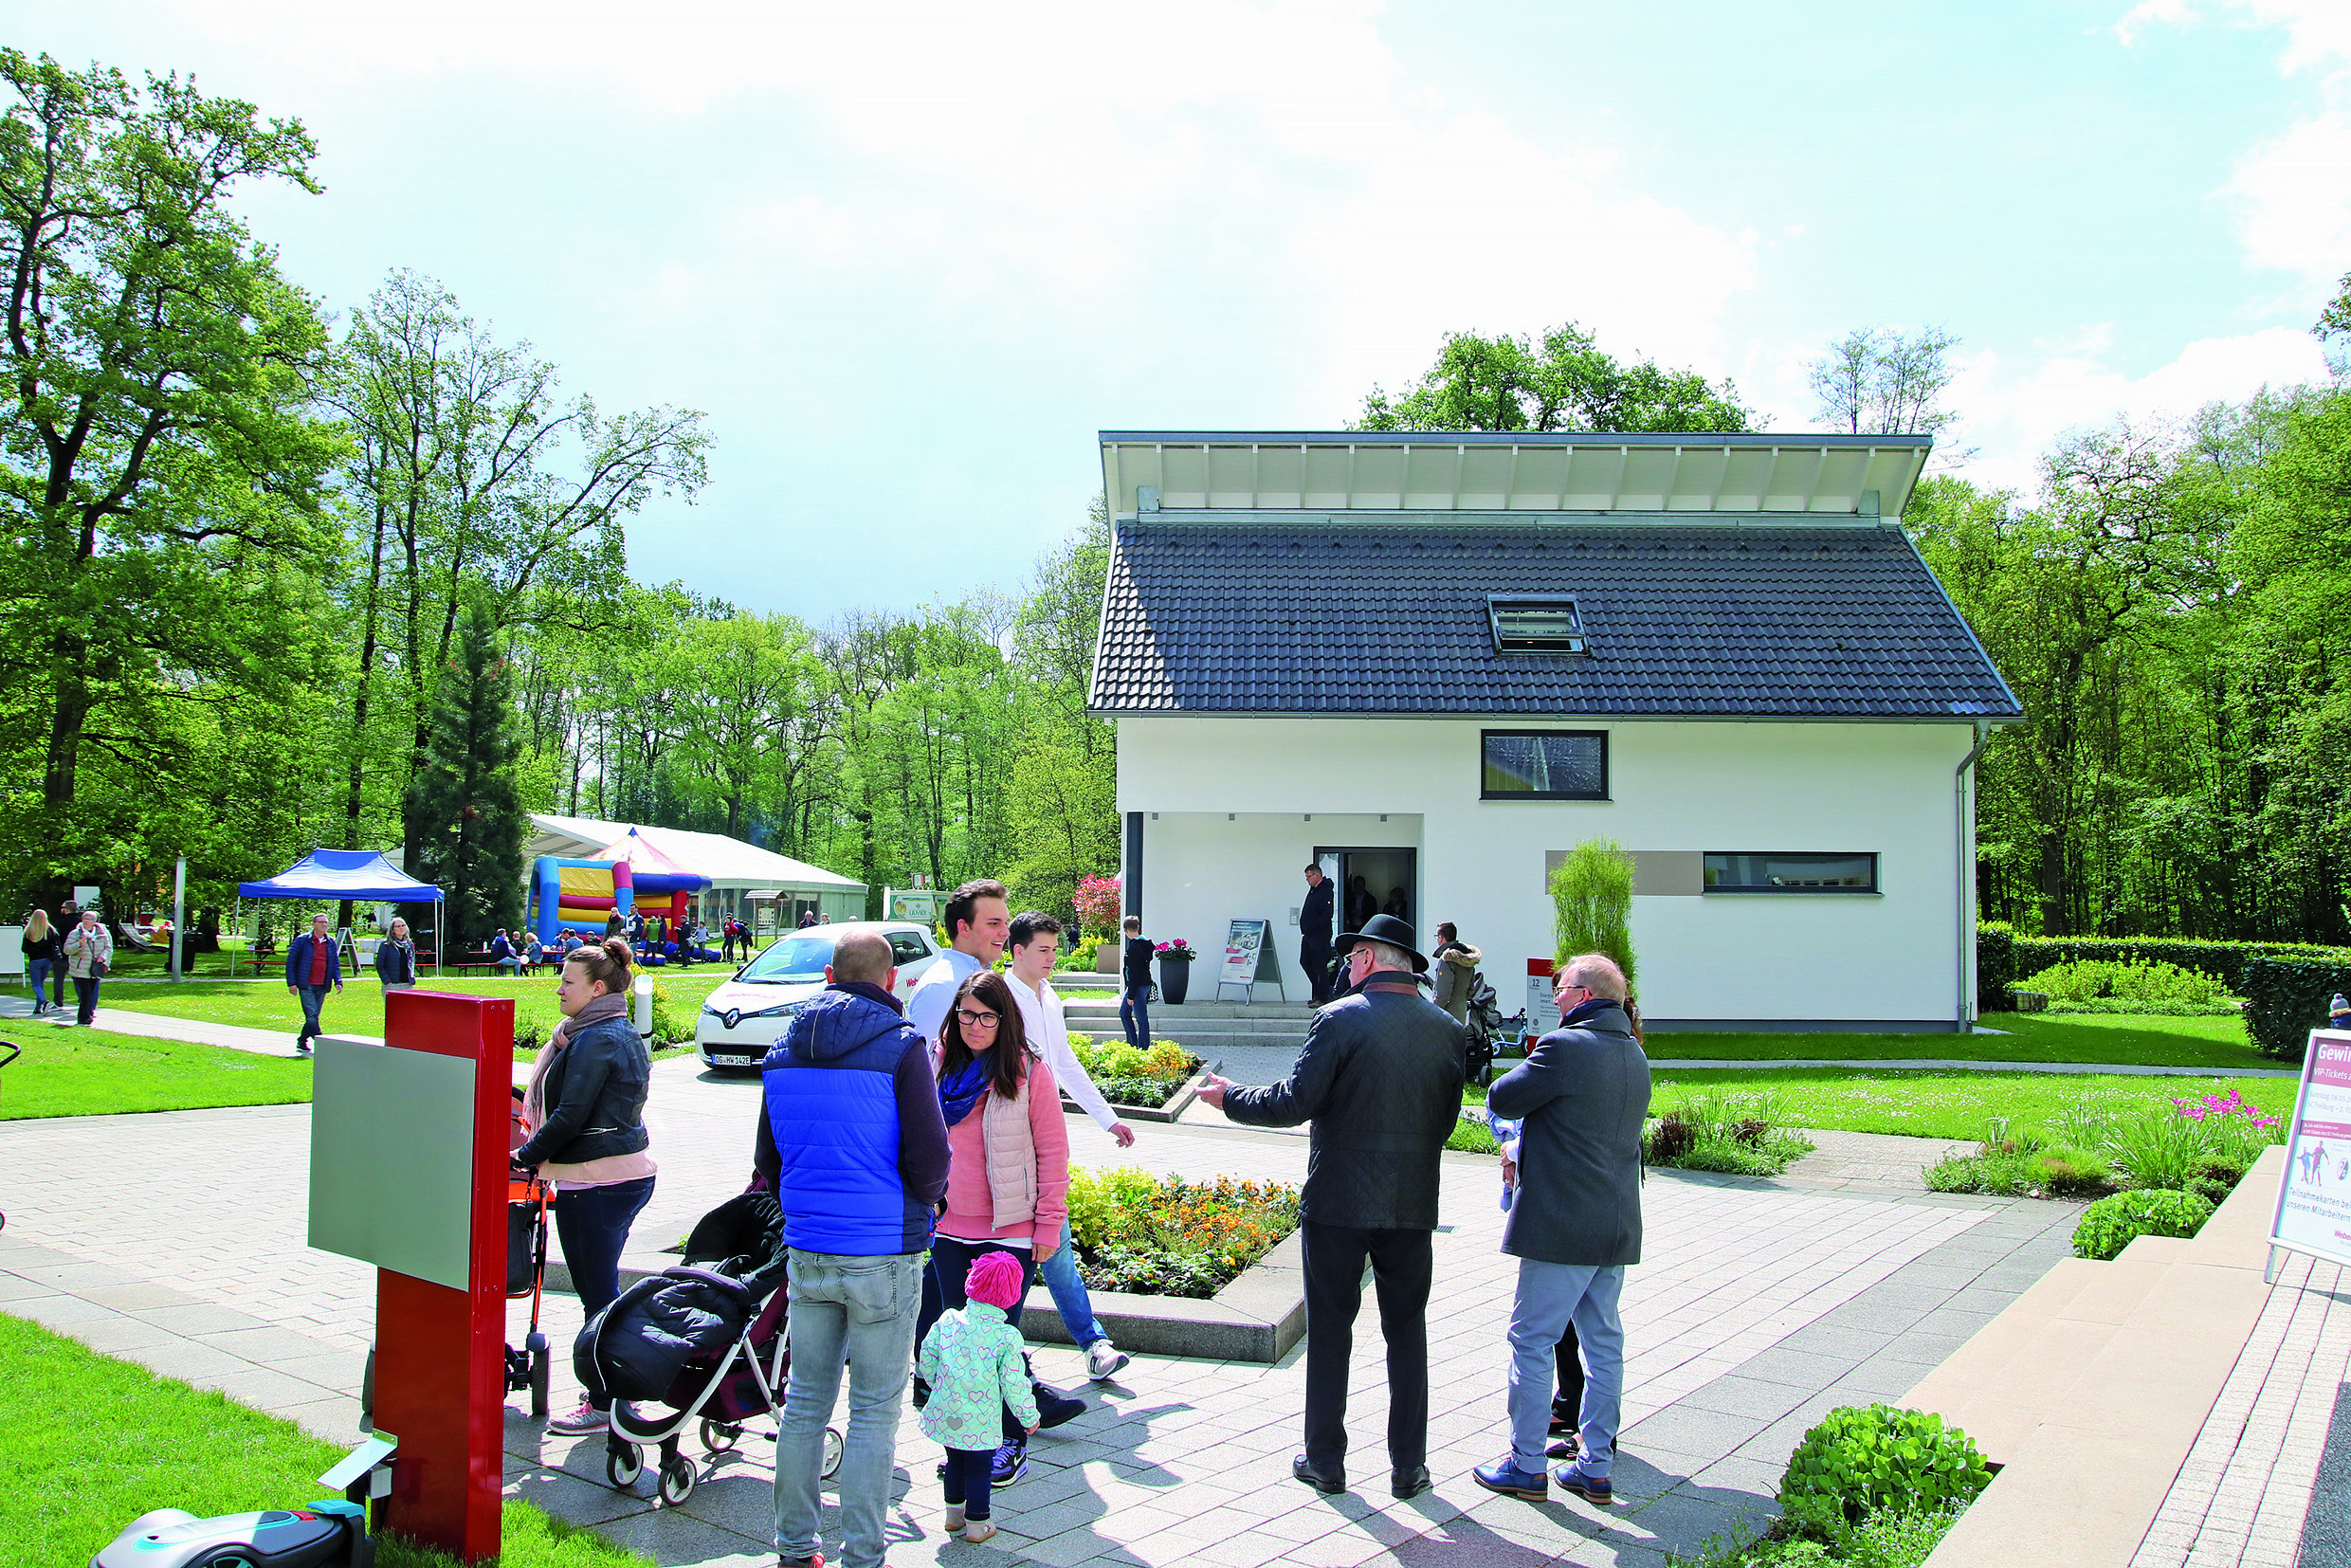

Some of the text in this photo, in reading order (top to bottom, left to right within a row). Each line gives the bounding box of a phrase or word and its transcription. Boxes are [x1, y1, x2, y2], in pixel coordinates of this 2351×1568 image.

[1532, 978, 1540, 987] 12
[2314, 1067, 2348, 1080] VIP-Tickets
[2288, 1187, 2341, 1207] Teilnahmekarten
[2286, 1200, 2351, 1222] unseren Mitarbeitern
